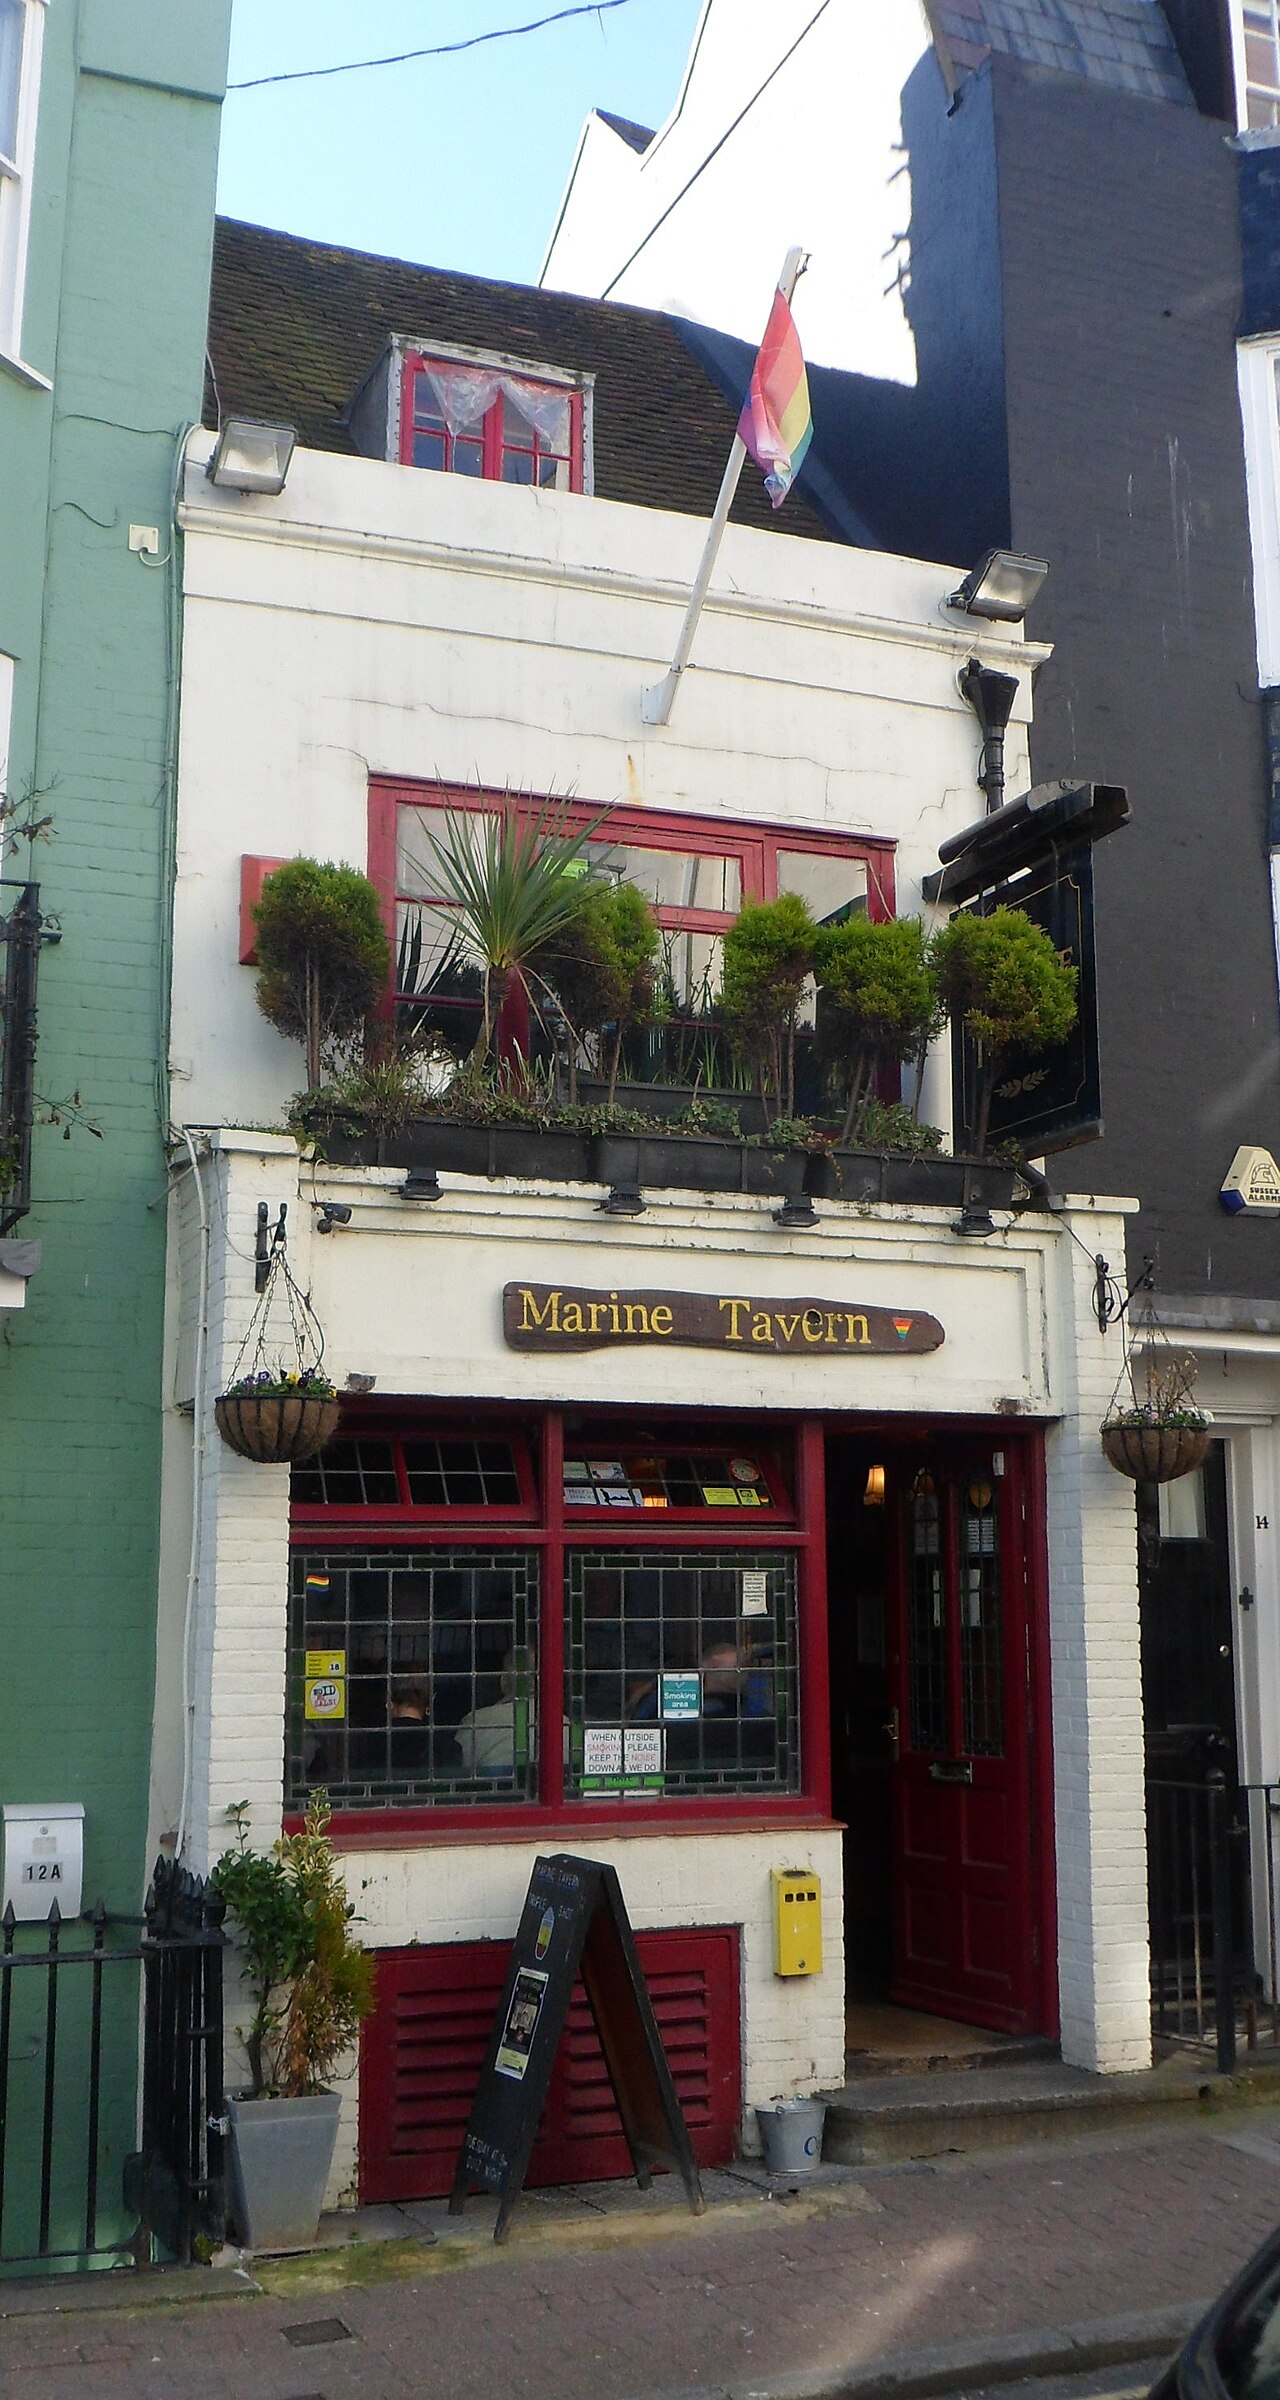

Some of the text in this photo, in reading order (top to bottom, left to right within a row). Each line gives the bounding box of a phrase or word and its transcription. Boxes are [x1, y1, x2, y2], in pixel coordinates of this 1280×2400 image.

[1249, 1187, 1280, 1195] SUSSEX
[516, 1289, 872, 1345] Marine Tavern
[1255, 1515, 1270, 1530] 14
[330, 1663, 340, 1671] 18
[664, 1691, 697, 1701] Smoking
[591, 1733, 617, 1741] WHEN
[627, 1743, 659, 1751] PLEASE
[589, 1753, 612, 1762] KEEP
[631, 1753, 656, 1761] NOISE
[588, 1763, 657, 1772] DOWN A WE DO
[26, 1864, 61, 1881] 12A
